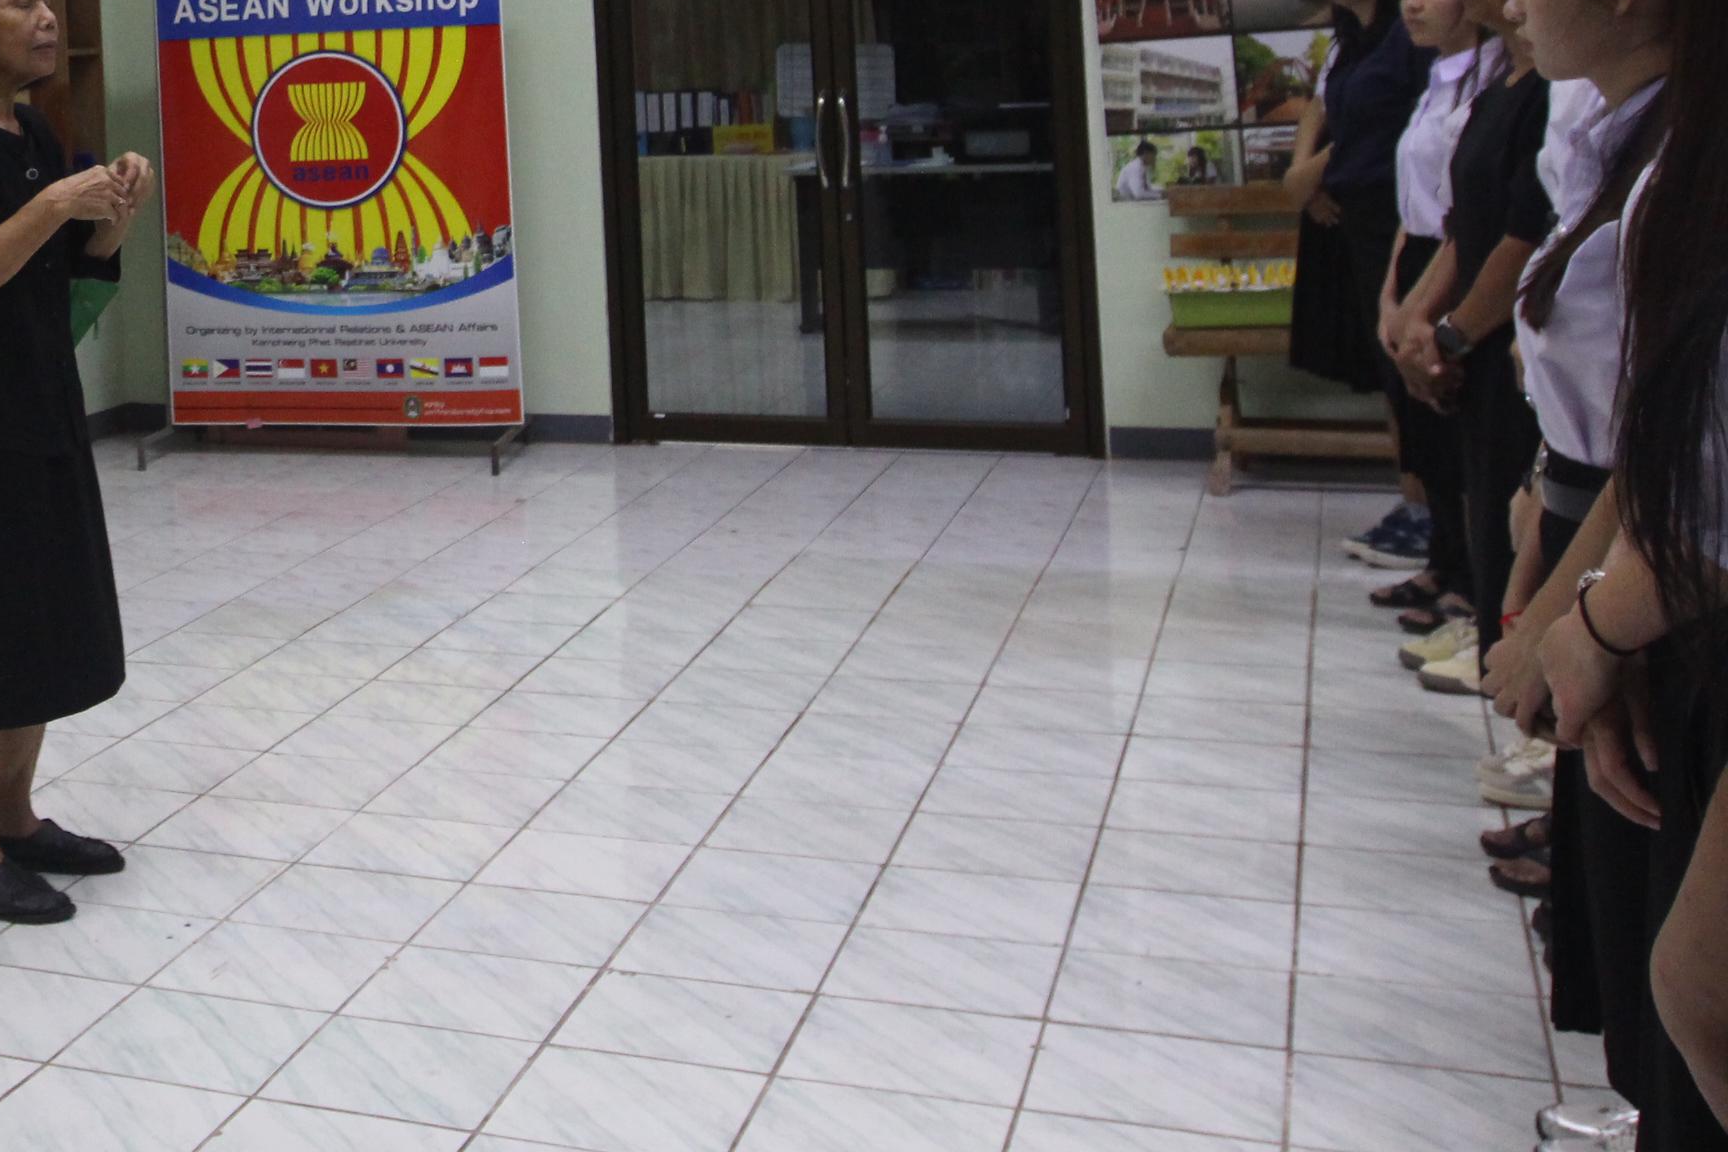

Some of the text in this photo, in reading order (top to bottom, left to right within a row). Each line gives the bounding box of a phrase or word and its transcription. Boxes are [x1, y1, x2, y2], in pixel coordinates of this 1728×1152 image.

[293, 164, 369, 182] asean
[245, 325, 259, 337] by
[409, 323, 454, 333] ASEAN
[458, 321, 499, 332] Affairs
[379, 336, 429, 349] University
